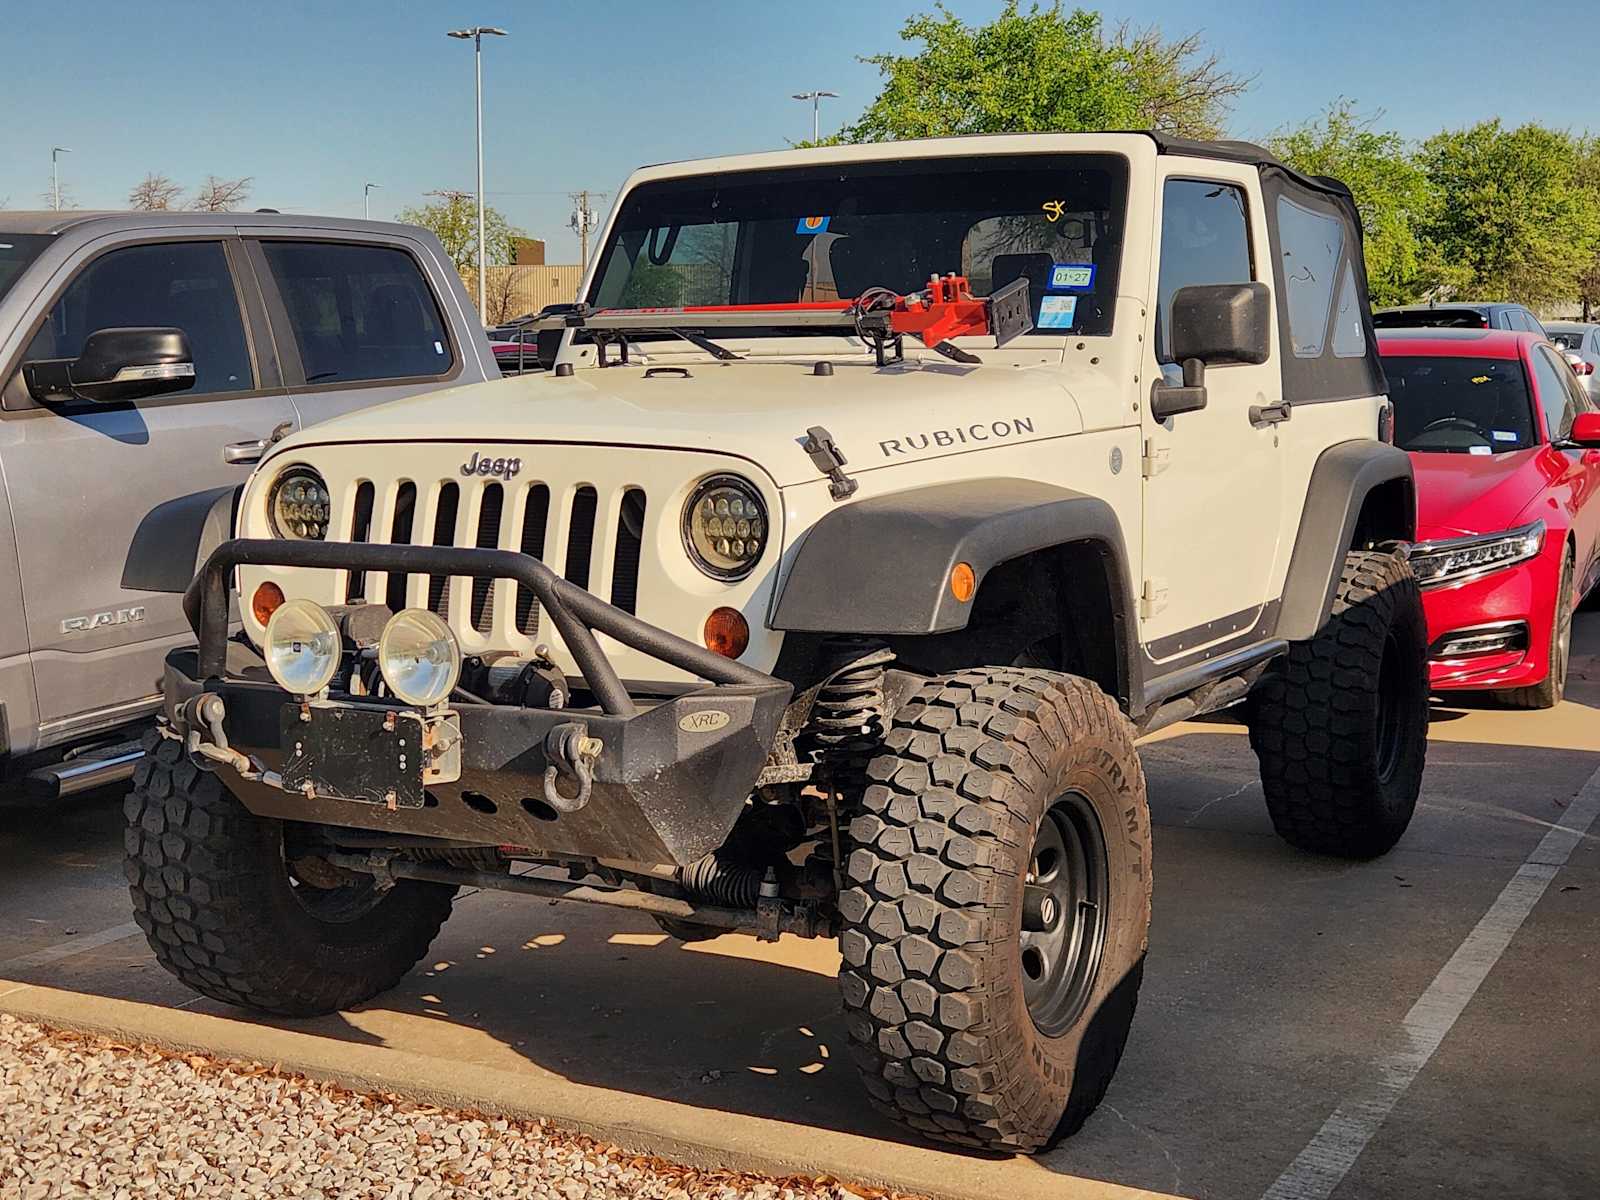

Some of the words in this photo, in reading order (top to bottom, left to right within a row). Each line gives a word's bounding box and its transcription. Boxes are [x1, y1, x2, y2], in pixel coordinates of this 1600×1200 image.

[878, 417, 1035, 457] RUBICON
[460, 451, 522, 481] Jeep
[61, 606, 145, 634] RAM
